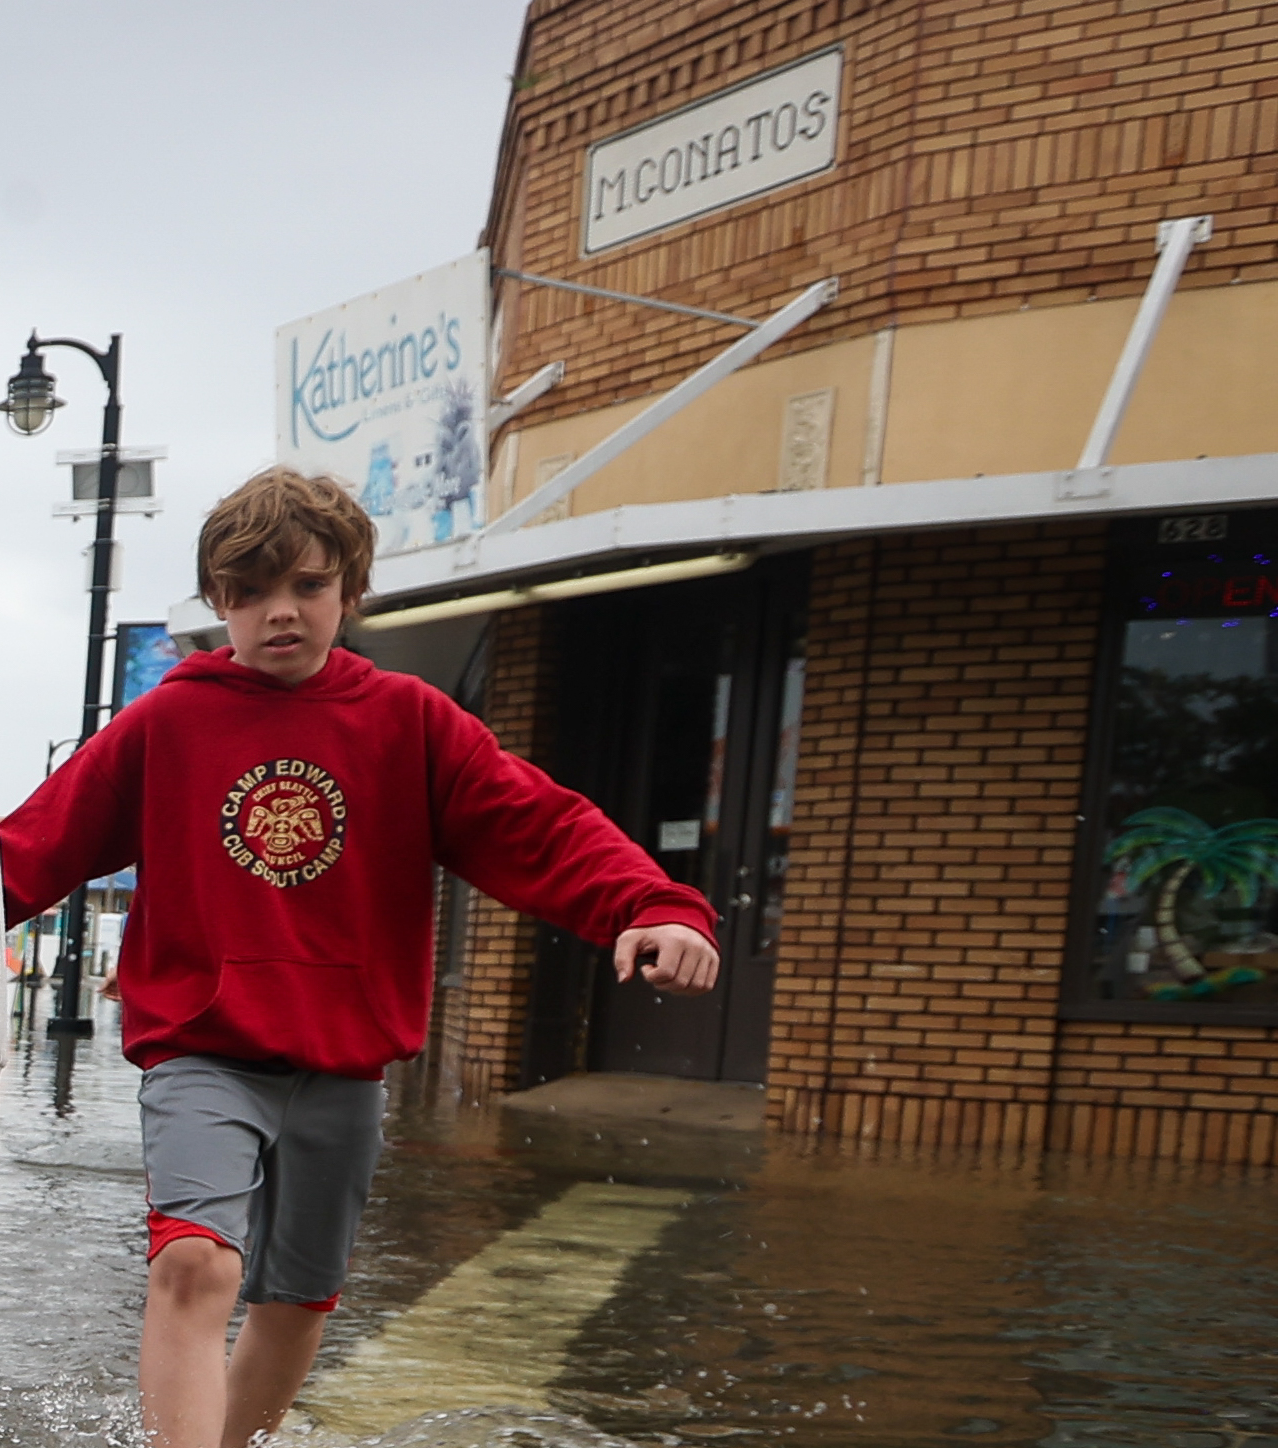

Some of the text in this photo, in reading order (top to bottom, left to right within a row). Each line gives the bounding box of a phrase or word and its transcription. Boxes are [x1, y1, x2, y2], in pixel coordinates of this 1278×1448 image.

[290, 310, 462, 449] Katherine's
[221, 759, 347, 820] CAMP EDWARD
[252, 780, 320, 805] CHIEF SEATTLE
[222, 834, 255, 867] CUB
[301, 837, 345, 881] CAMP
